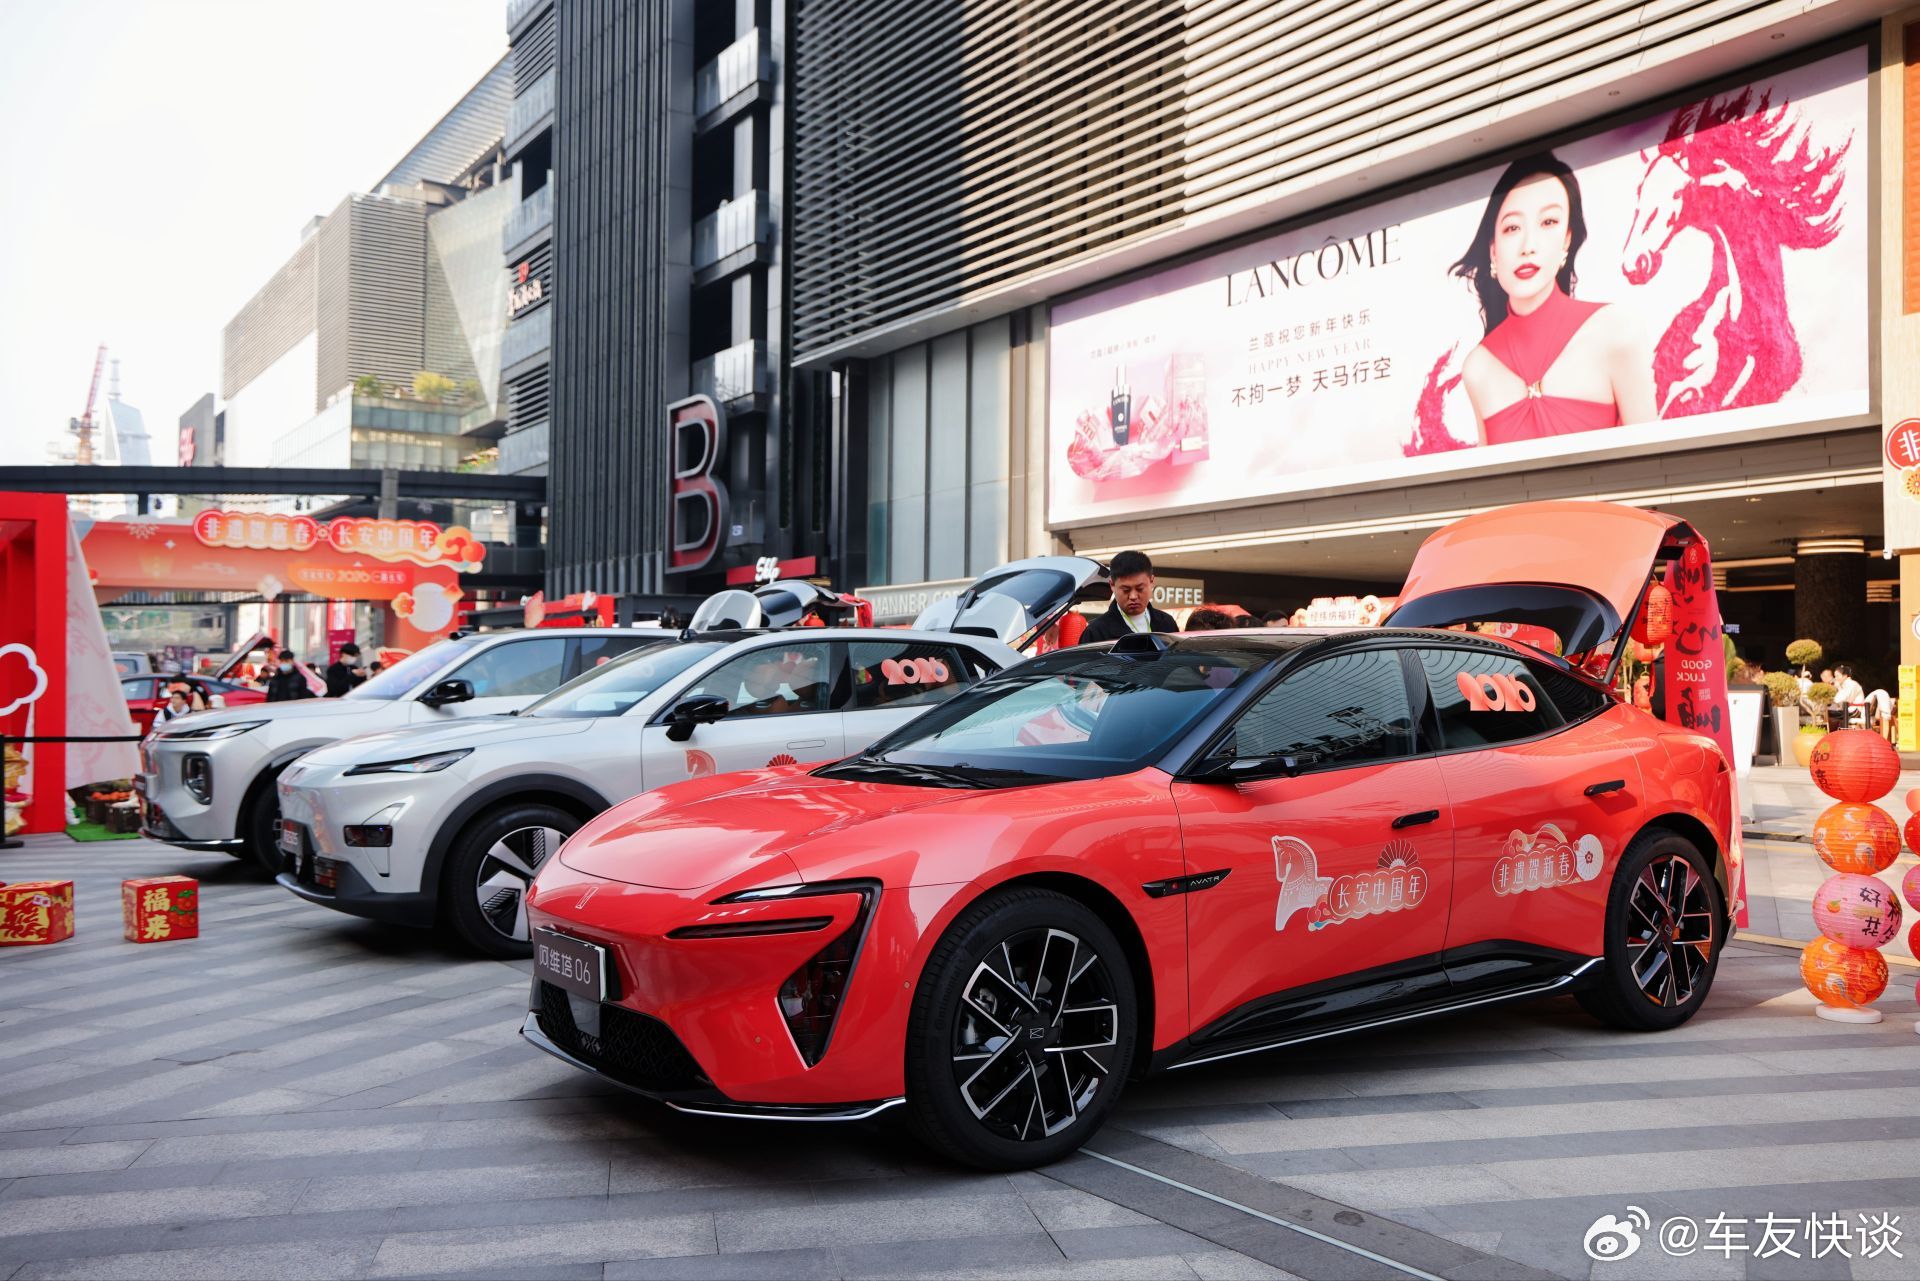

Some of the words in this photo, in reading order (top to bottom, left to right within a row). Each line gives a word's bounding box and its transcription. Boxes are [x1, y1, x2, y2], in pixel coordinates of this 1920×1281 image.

[1227, 224, 1401, 307] LANCÔME
[1248, 308, 1371, 352] 兰蔻祝您新年快乐
[1249, 355, 1290, 375] HAPPY
[1297, 348, 1327, 364] NEW
[1334, 338, 1371, 356] YEAR
[1231, 374, 1302, 407] 不拘一梦
[1312, 356, 1392, 392] 天马行空
[1898, 429, 1920, 462] 非
[665, 394, 728, 574] B
[872, 594, 928, 616] MANNER
[1151, 587, 1203, 605] OFFEE
[881, 656, 949, 685] 2026
[1456, 671, 1536, 712] 2026
[1190, 875, 1220, 886] AVATR
[1498, 851, 1569, 888] 非遗贺新春
[1337, 874, 1421, 909] 长安中国年
